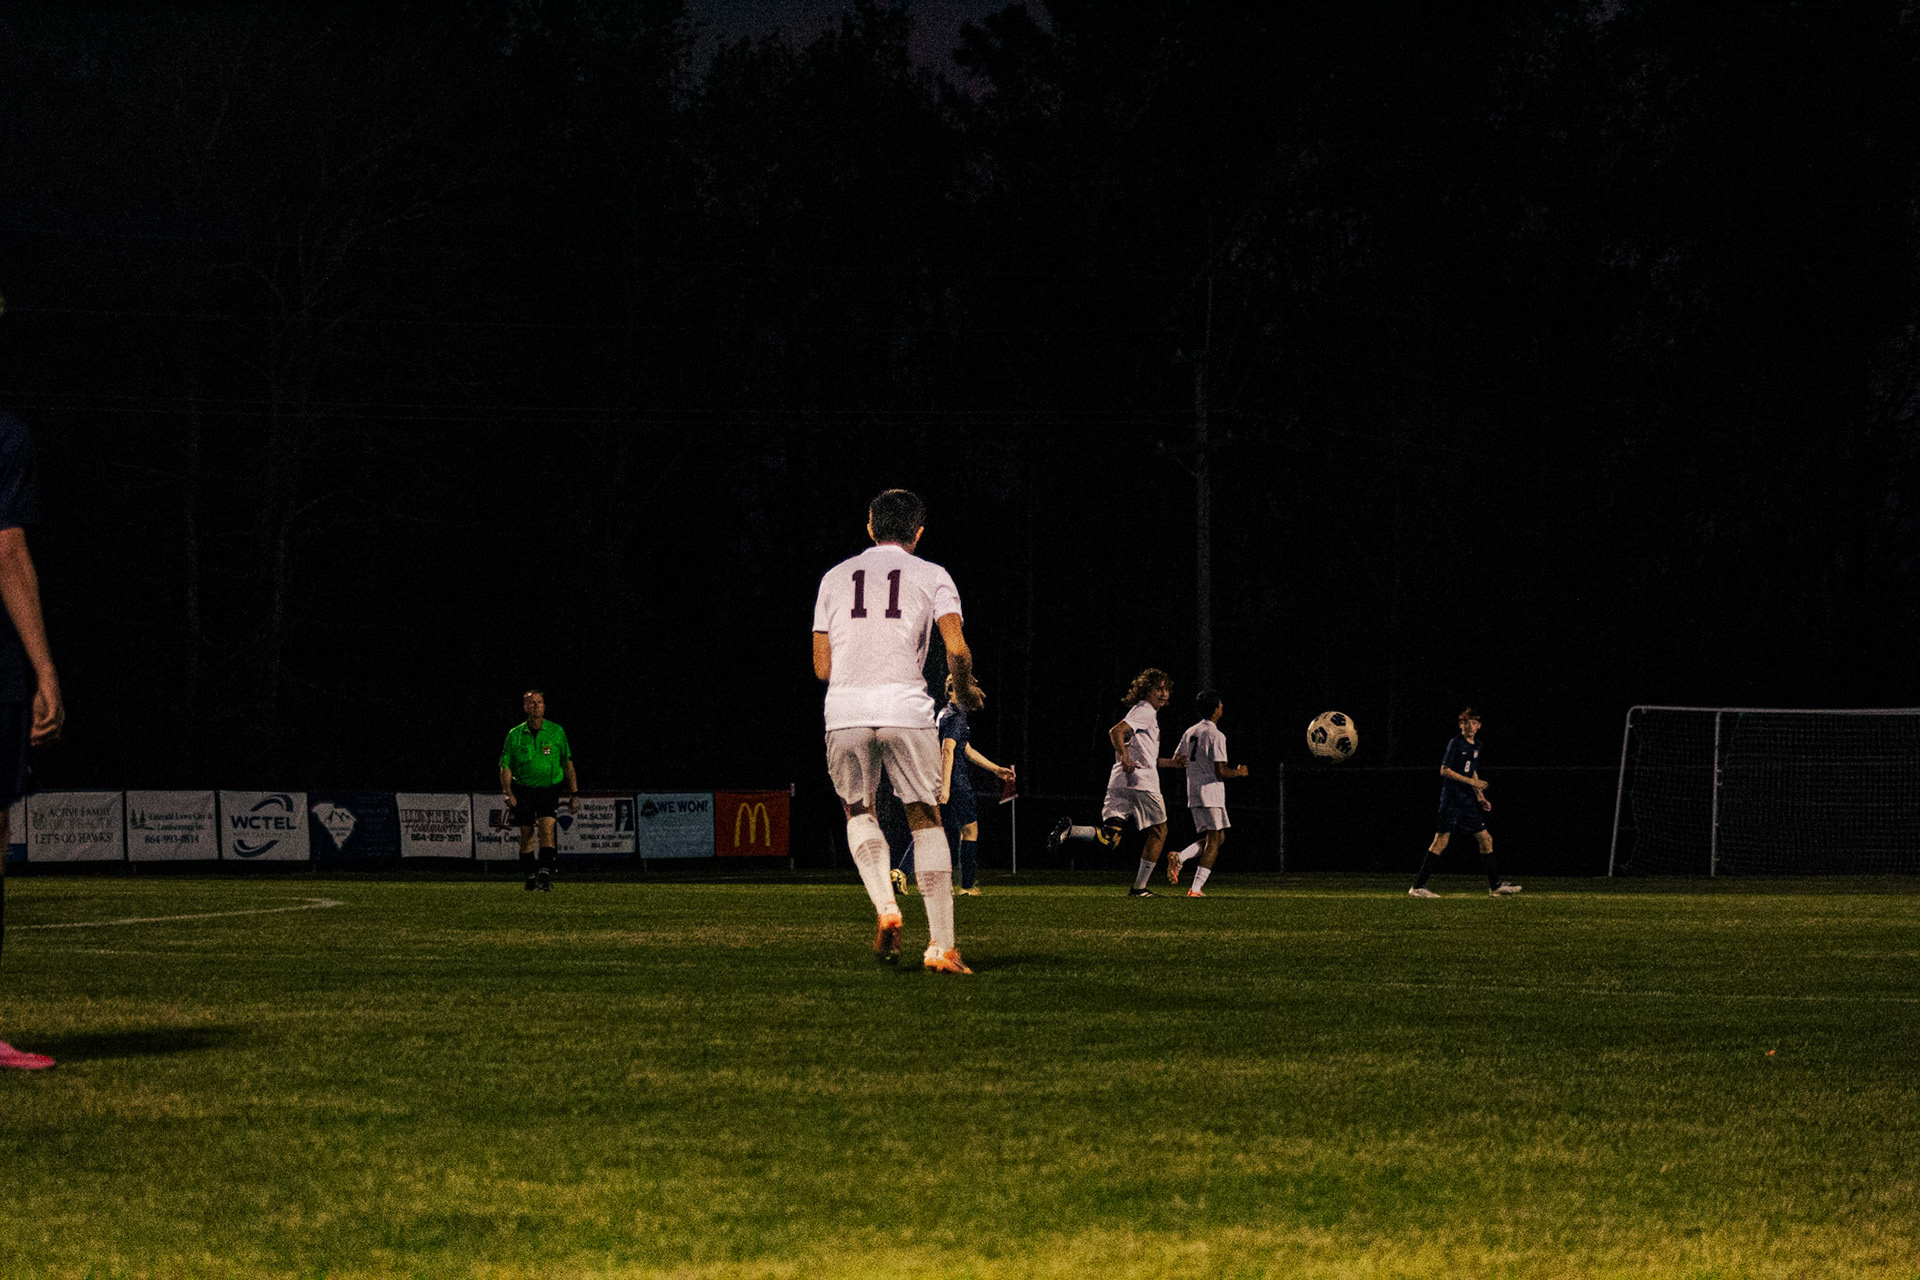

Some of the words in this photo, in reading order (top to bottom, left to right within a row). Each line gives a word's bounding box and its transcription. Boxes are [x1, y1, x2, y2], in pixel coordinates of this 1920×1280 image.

[851, 569, 901, 619] 11
[657, 801, 675, 813] WE
[677, 800, 708, 813] WON!
[230, 815, 297, 830] WCTEL
[61, 832, 76, 844] GO
